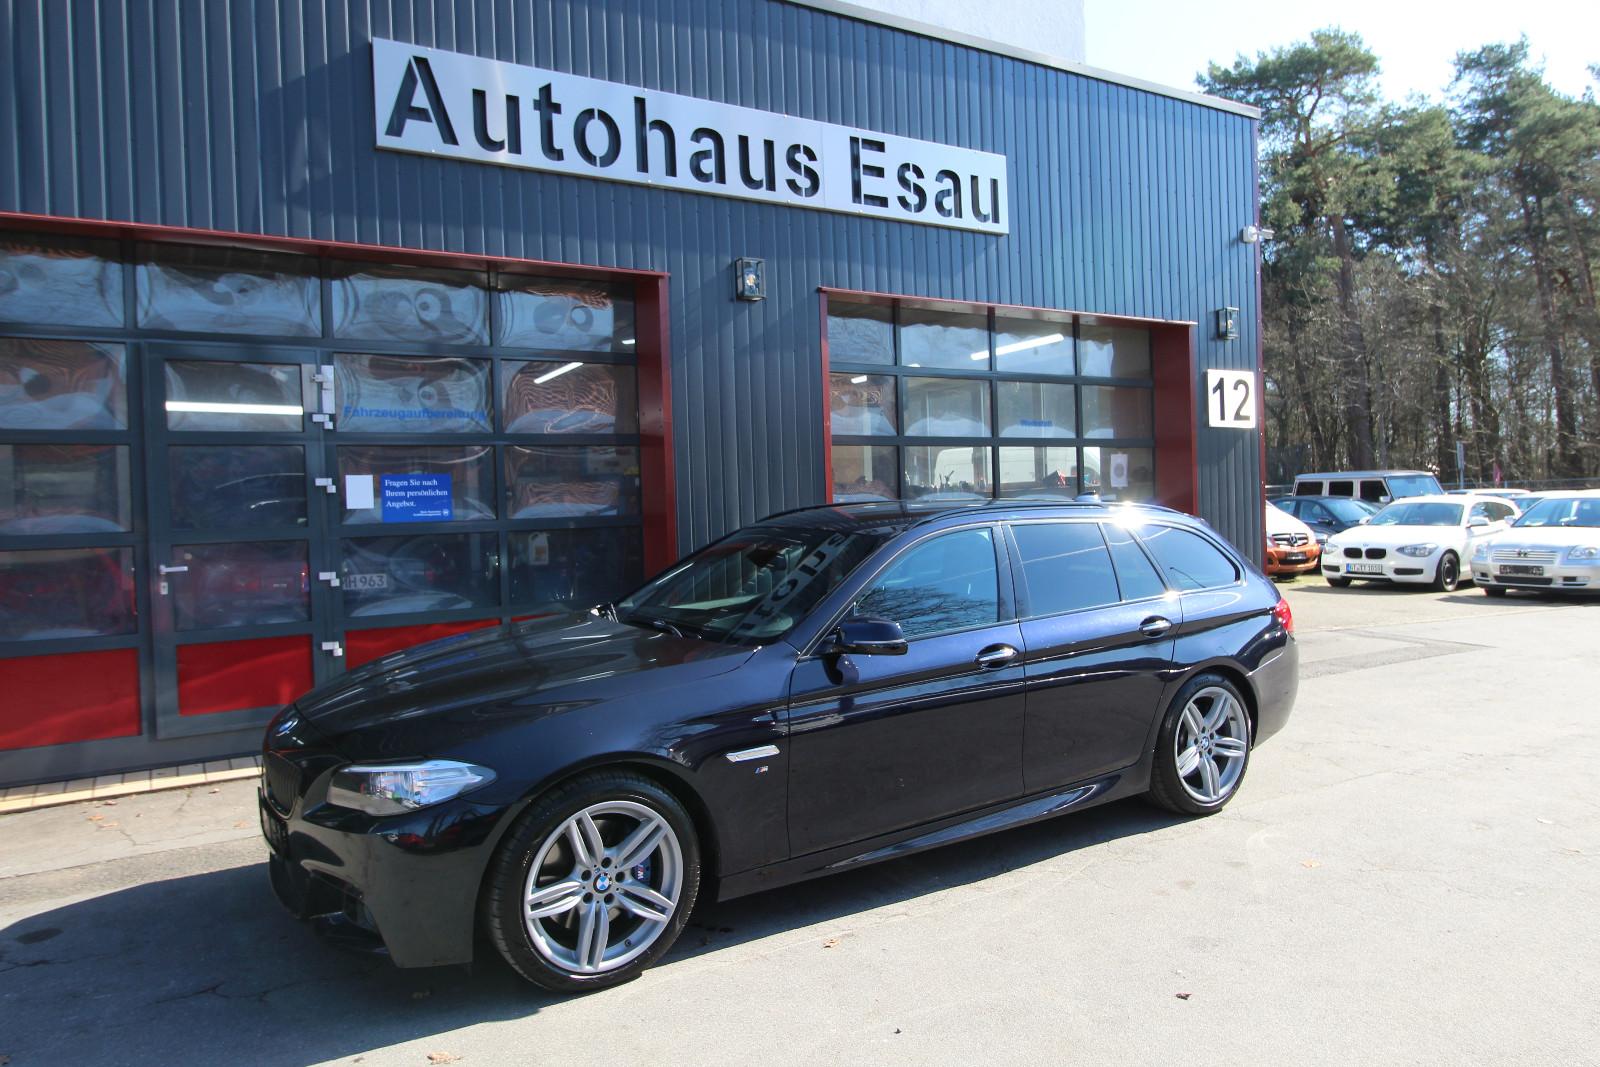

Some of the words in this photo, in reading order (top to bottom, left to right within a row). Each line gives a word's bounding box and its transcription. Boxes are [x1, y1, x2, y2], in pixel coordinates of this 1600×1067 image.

[385, 55, 820, 198] Autohaus
[850, 135, 1000, 224] Esau
[1212, 377, 1250, 421] 12
[384, 479, 408, 488] Fragen
[422, 478, 438, 486] nach
[407, 489, 448, 498] persönlichen
[359, 575, 385, 588] 963
